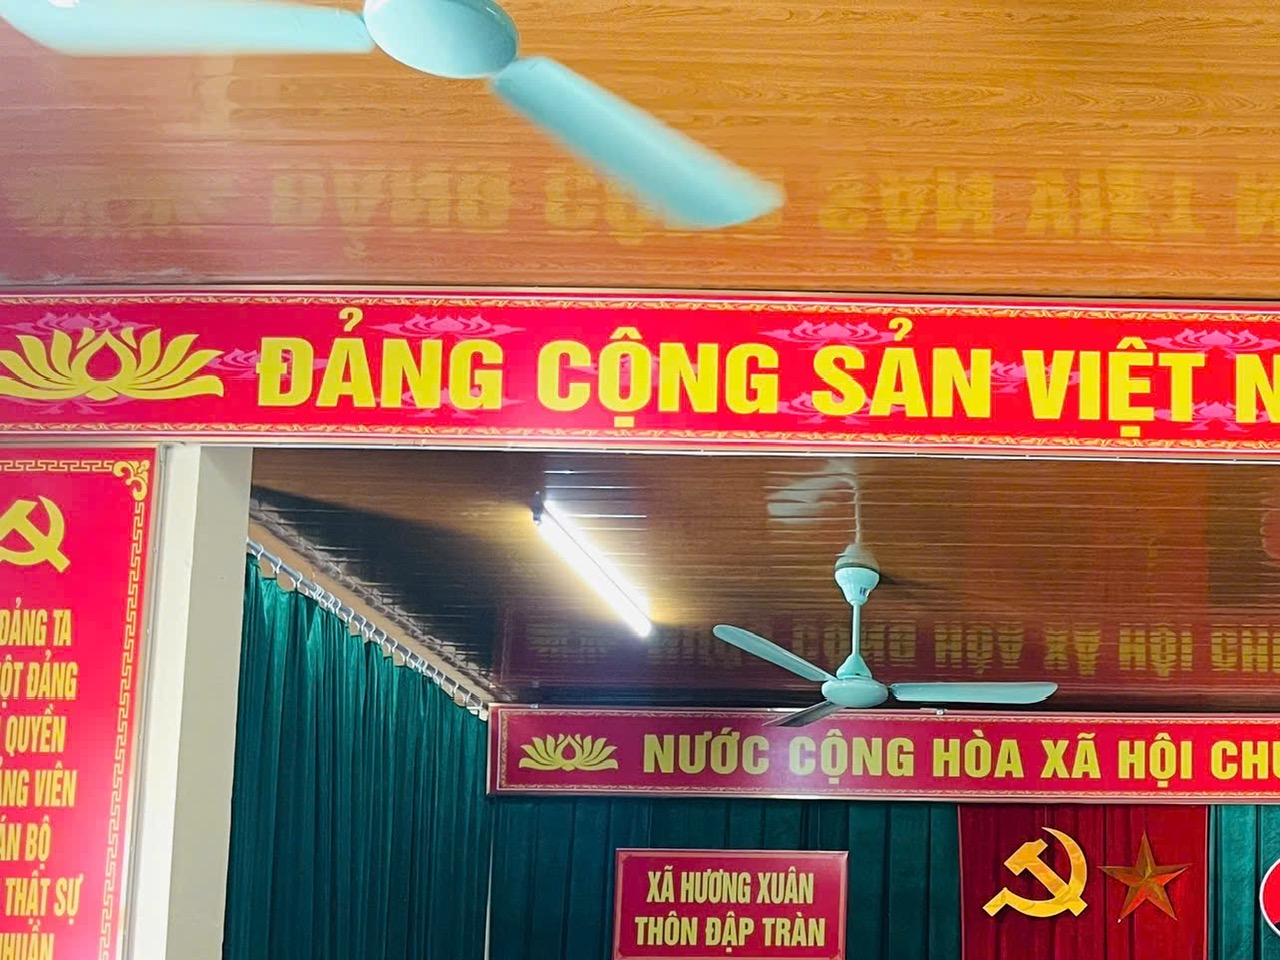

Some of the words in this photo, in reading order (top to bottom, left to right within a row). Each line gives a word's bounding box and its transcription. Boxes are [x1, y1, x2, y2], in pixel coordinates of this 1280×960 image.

[256, 307, 503, 410] ĐẢNG
[537, 326, 780, 429] CỘNG
[811, 317, 991, 419] SẢN
[1022, 336, 1205, 437] VIỆT
[0, 597, 48, 647] ĐẢNG
[53, 608, 73, 647] TA
[0, 654, 24, 709] ỘT
[27, 649, 79, 700] ĐẢNG
[5, 703, 66, 757] QUYỀN
[0, 756, 30, 808] NG
[35, 761, 77, 807] VIÊN
[643, 727, 770, 773] NƯỚC
[789, 731, 914, 784] CỘNG
[933, 729, 1024, 778] HÒA
[1041, 732, 1101, 778] XÃ
[1118, 732, 1193, 788] HỘI
[25, 815, 51, 870] BỘ
[5, 869, 51, 925] THẬT
[54, 873, 84, 925] SỰ
[646, 865, 675, 902] XÃ
[680, 869, 751, 904] HƯƠNG
[756, 866, 814, 904] XUÂN
[634, 911, 698, 946] THÔN
[705, 911, 755, 953] ĐẬP
[762, 912, 826, 947] TRÀN
